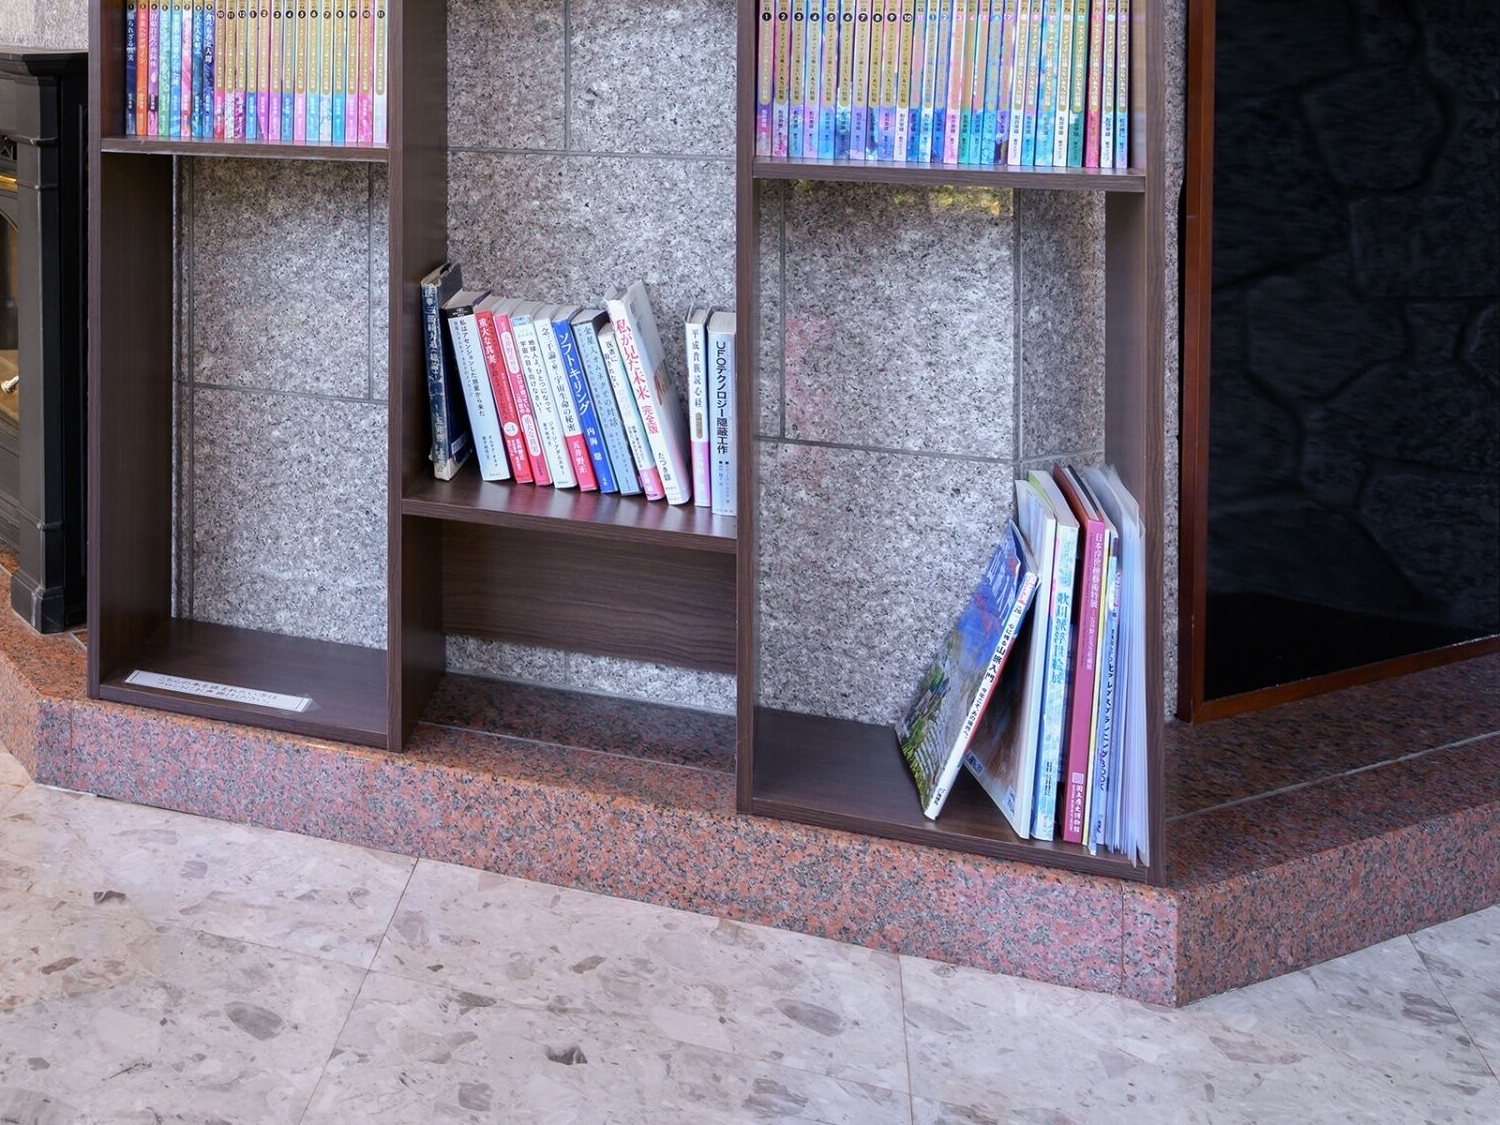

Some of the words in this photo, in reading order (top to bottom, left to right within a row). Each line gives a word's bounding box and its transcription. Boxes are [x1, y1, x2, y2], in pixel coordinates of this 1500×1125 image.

[479, 317, 497, 364] 重大な真実
[615, 318, 650, 400] 私が見た未来
[642, 405, 660, 435] 完全版
[715, 341, 729, 455] UFOテクノロジー隠蔽工作
